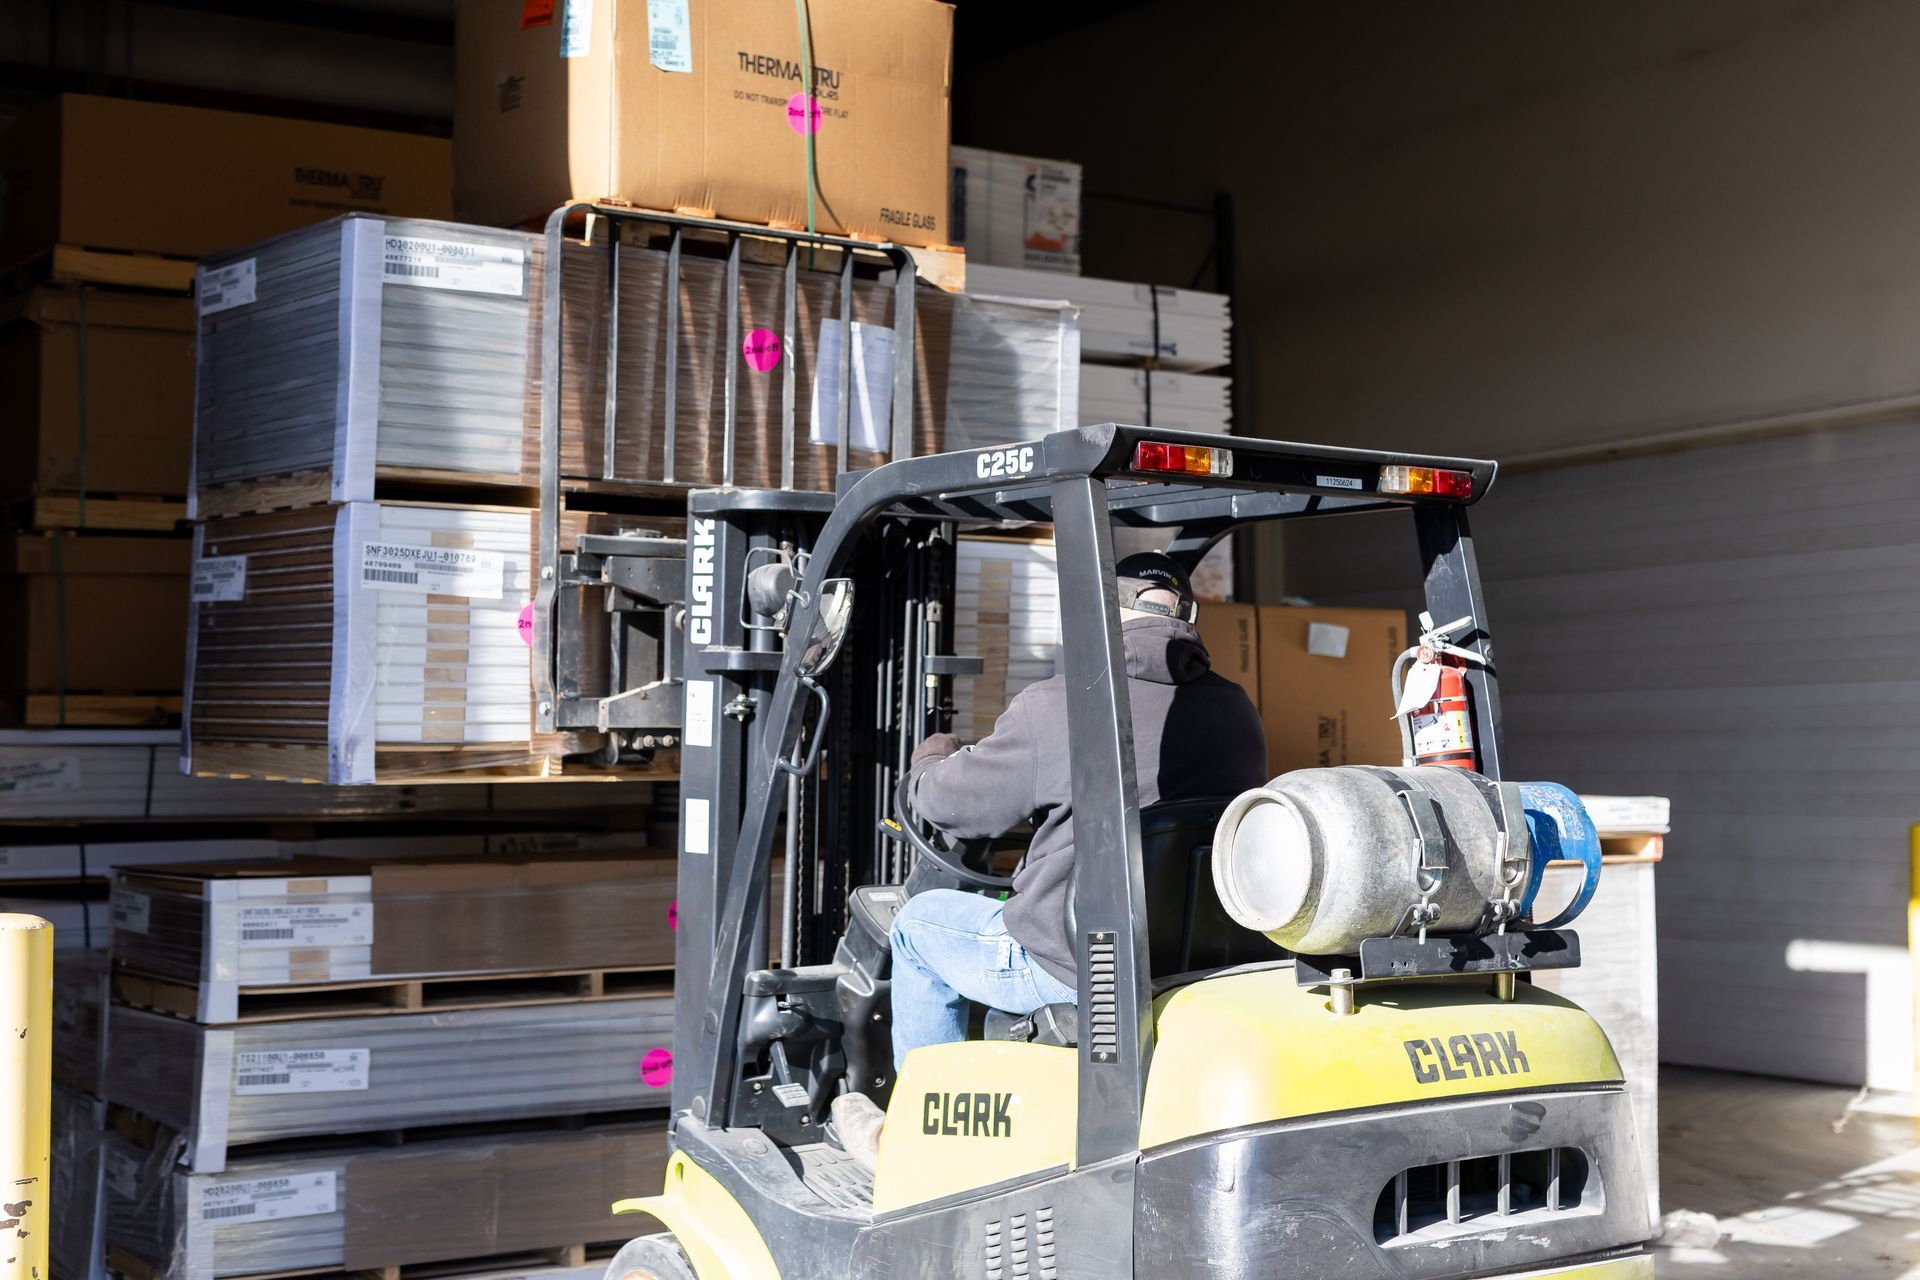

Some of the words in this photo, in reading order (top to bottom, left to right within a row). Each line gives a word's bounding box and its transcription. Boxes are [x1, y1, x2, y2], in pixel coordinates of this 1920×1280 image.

[737, 51, 803, 83] THERMA
[811, 65, 840, 89] TRU
[879, 207, 912, 227] FRAGILE
[911, 212, 937, 231] GLASS
[744, 345, 764, 356] 2nd
[976, 446, 1034, 479] C25C
[690, 518, 716, 645] CLARK
[1139, 568, 1173, 580] MARVIN
[1403, 1030, 1531, 1085] CLARK
[923, 1092, 1013, 1138] CLARK
